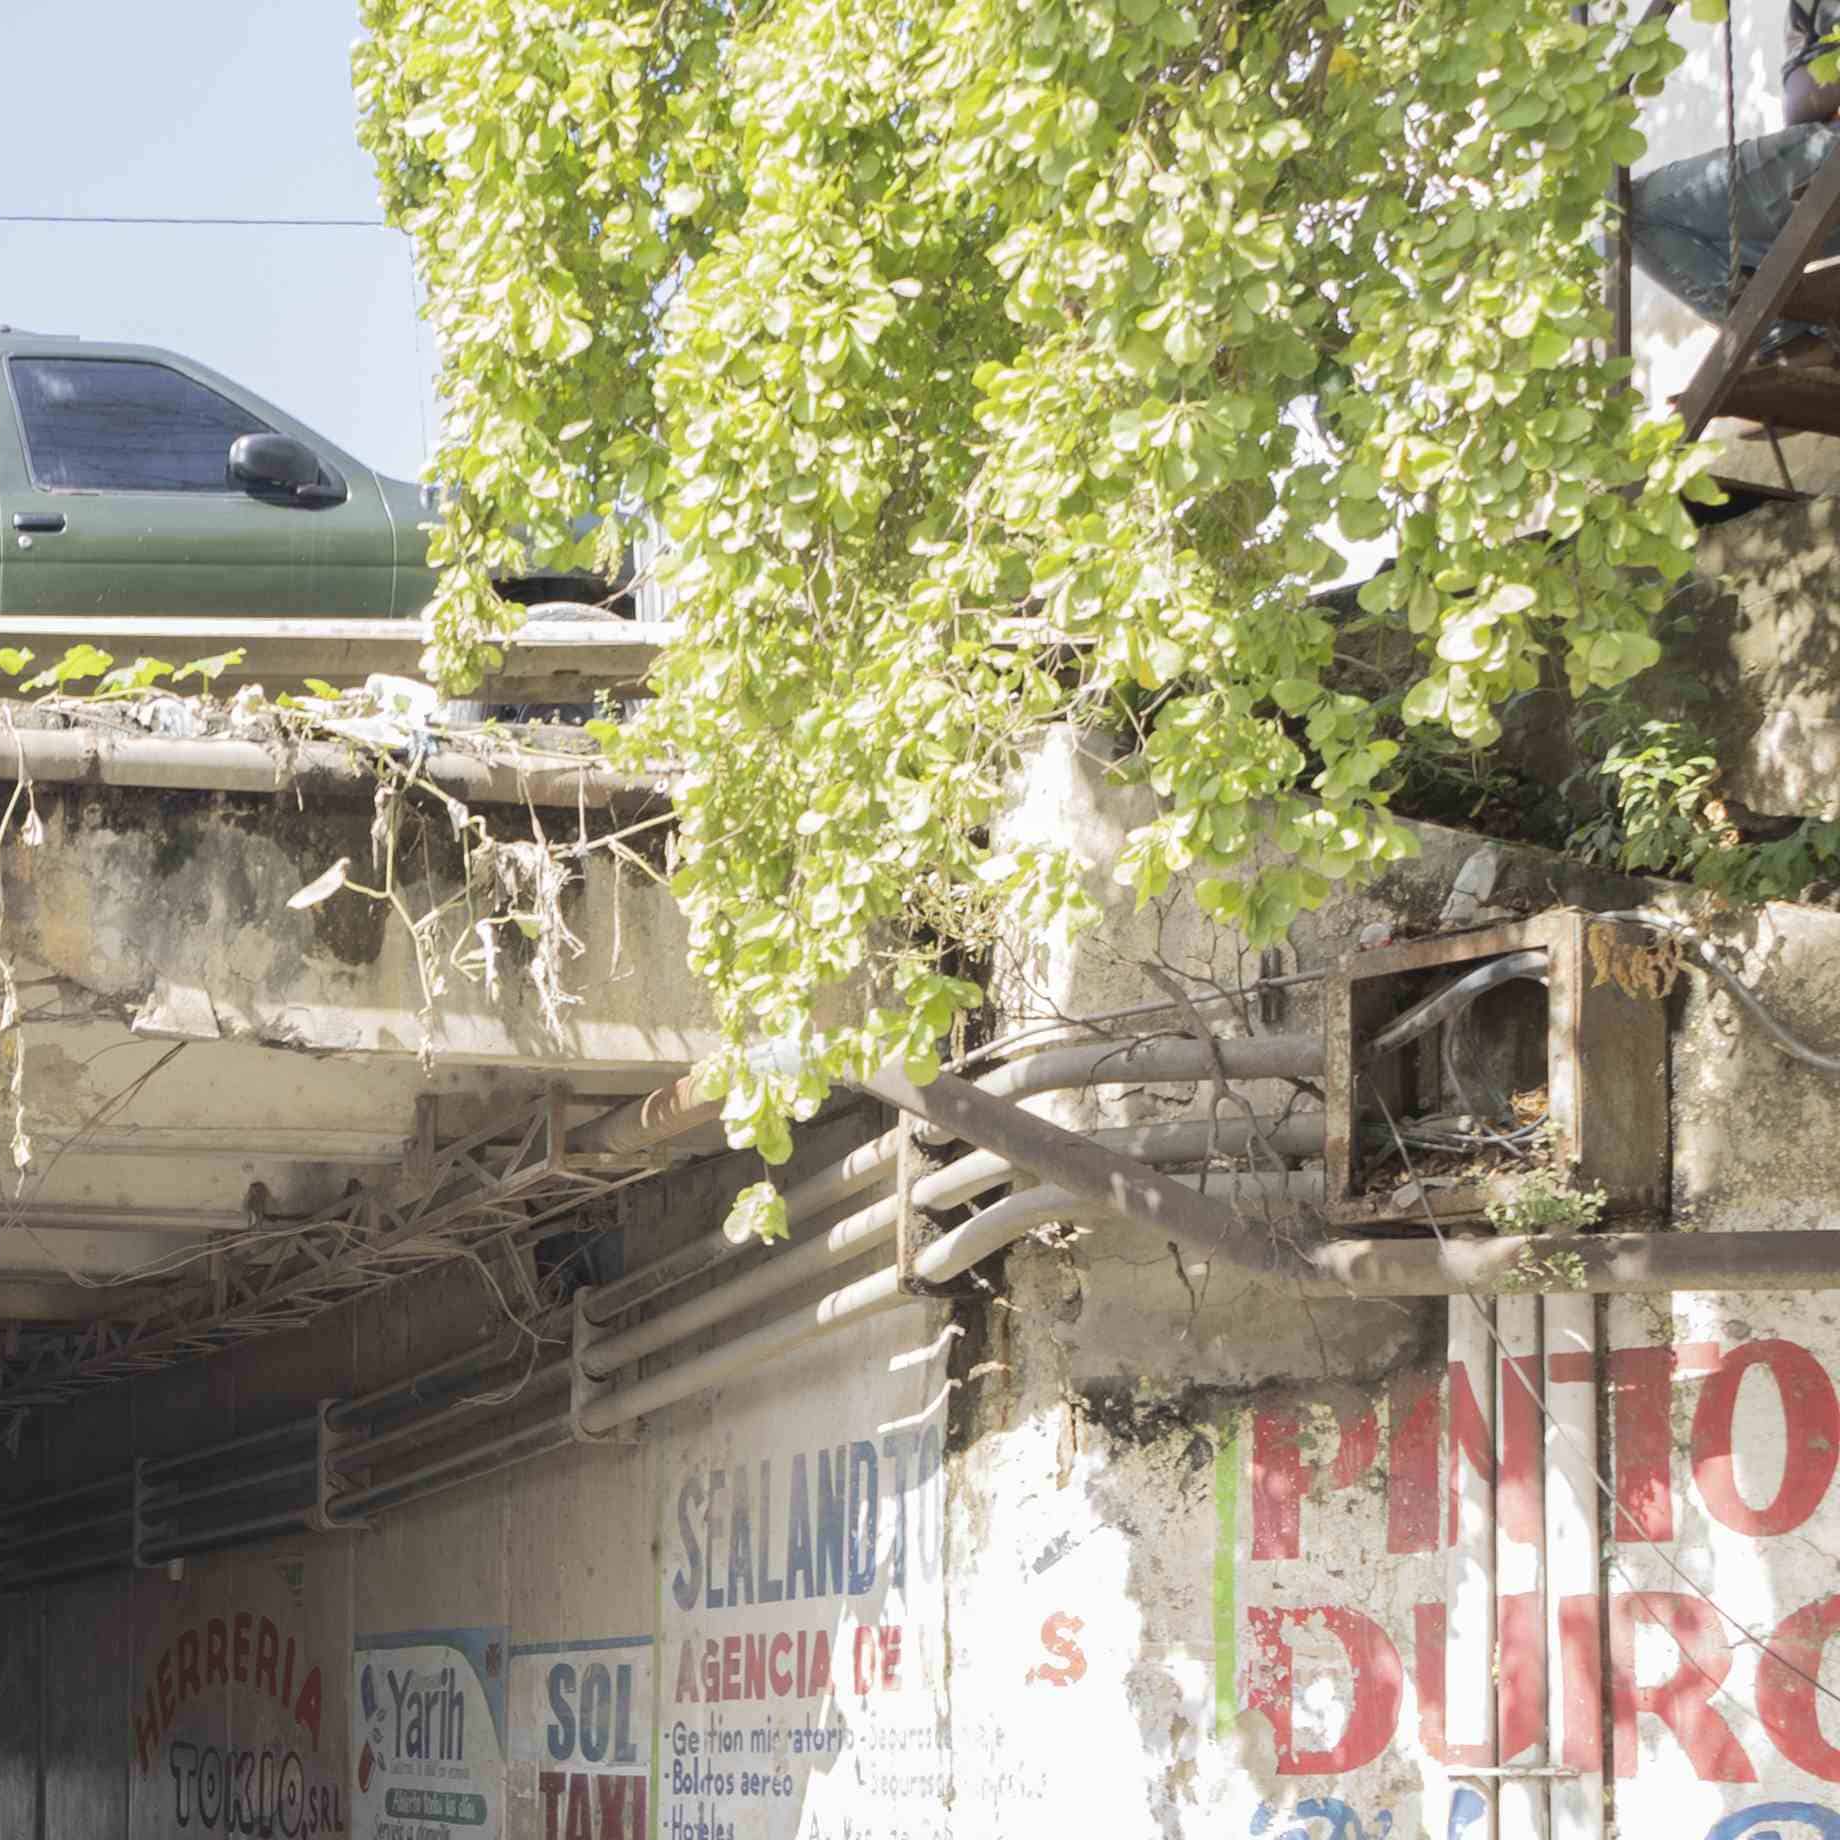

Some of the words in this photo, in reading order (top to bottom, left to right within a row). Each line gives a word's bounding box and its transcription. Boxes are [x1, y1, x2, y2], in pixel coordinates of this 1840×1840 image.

[672, 1440, 879, 1611] SEALAND
[1251, 1338, 1840, 1560] PINTO
[133, 1611, 321, 1780] HERRERIA
[546, 1662, 638, 1763] SOL
[674, 1628, 835, 1704] AGENCIA
